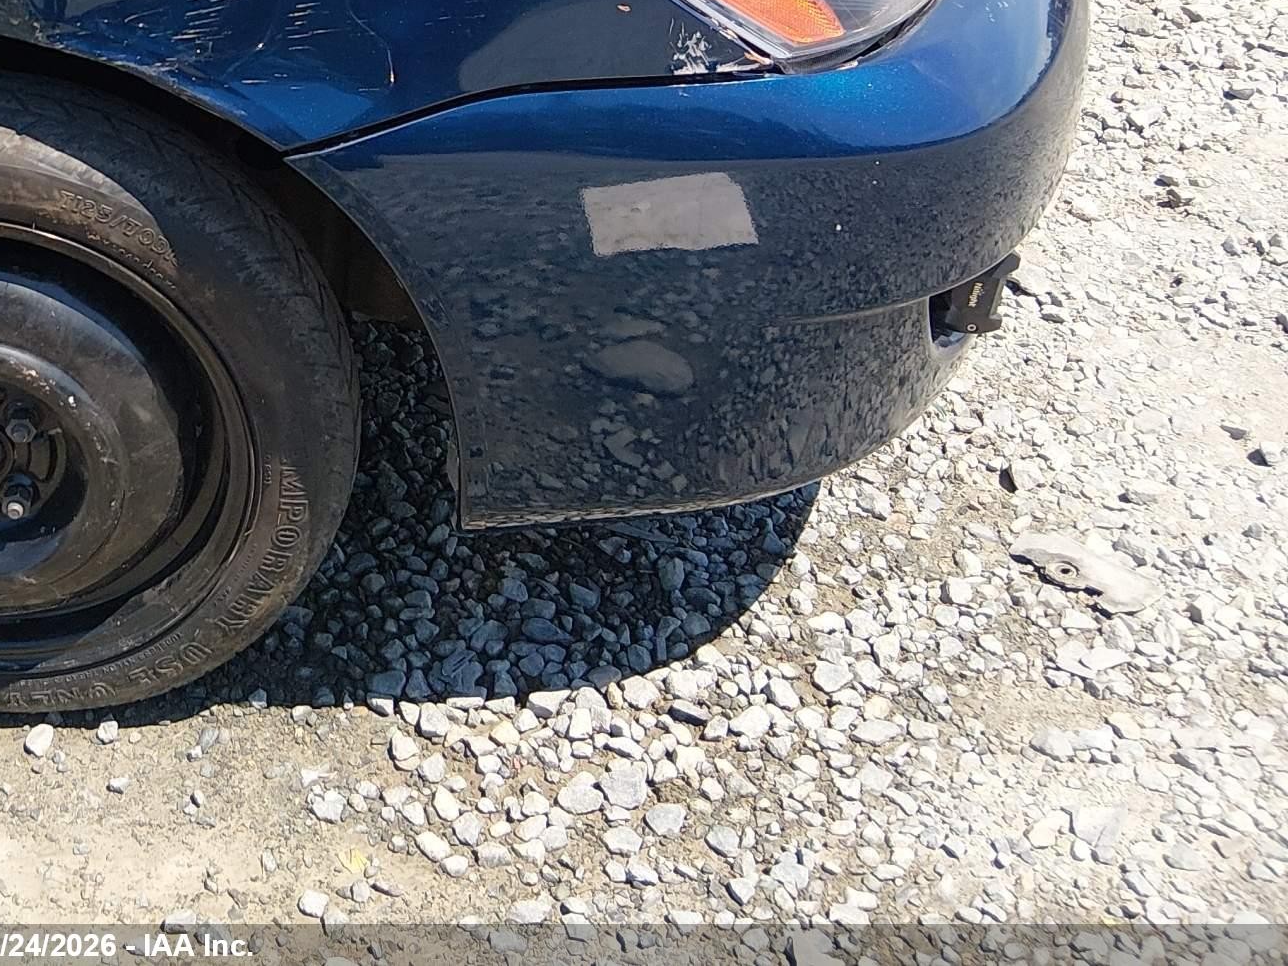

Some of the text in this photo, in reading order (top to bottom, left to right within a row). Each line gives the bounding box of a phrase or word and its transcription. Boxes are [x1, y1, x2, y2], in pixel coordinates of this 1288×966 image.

[214, 458, 310, 635] MPORARY
[128, 640, 214, 684] USE
[3, 681, 116, 710] ONLY
